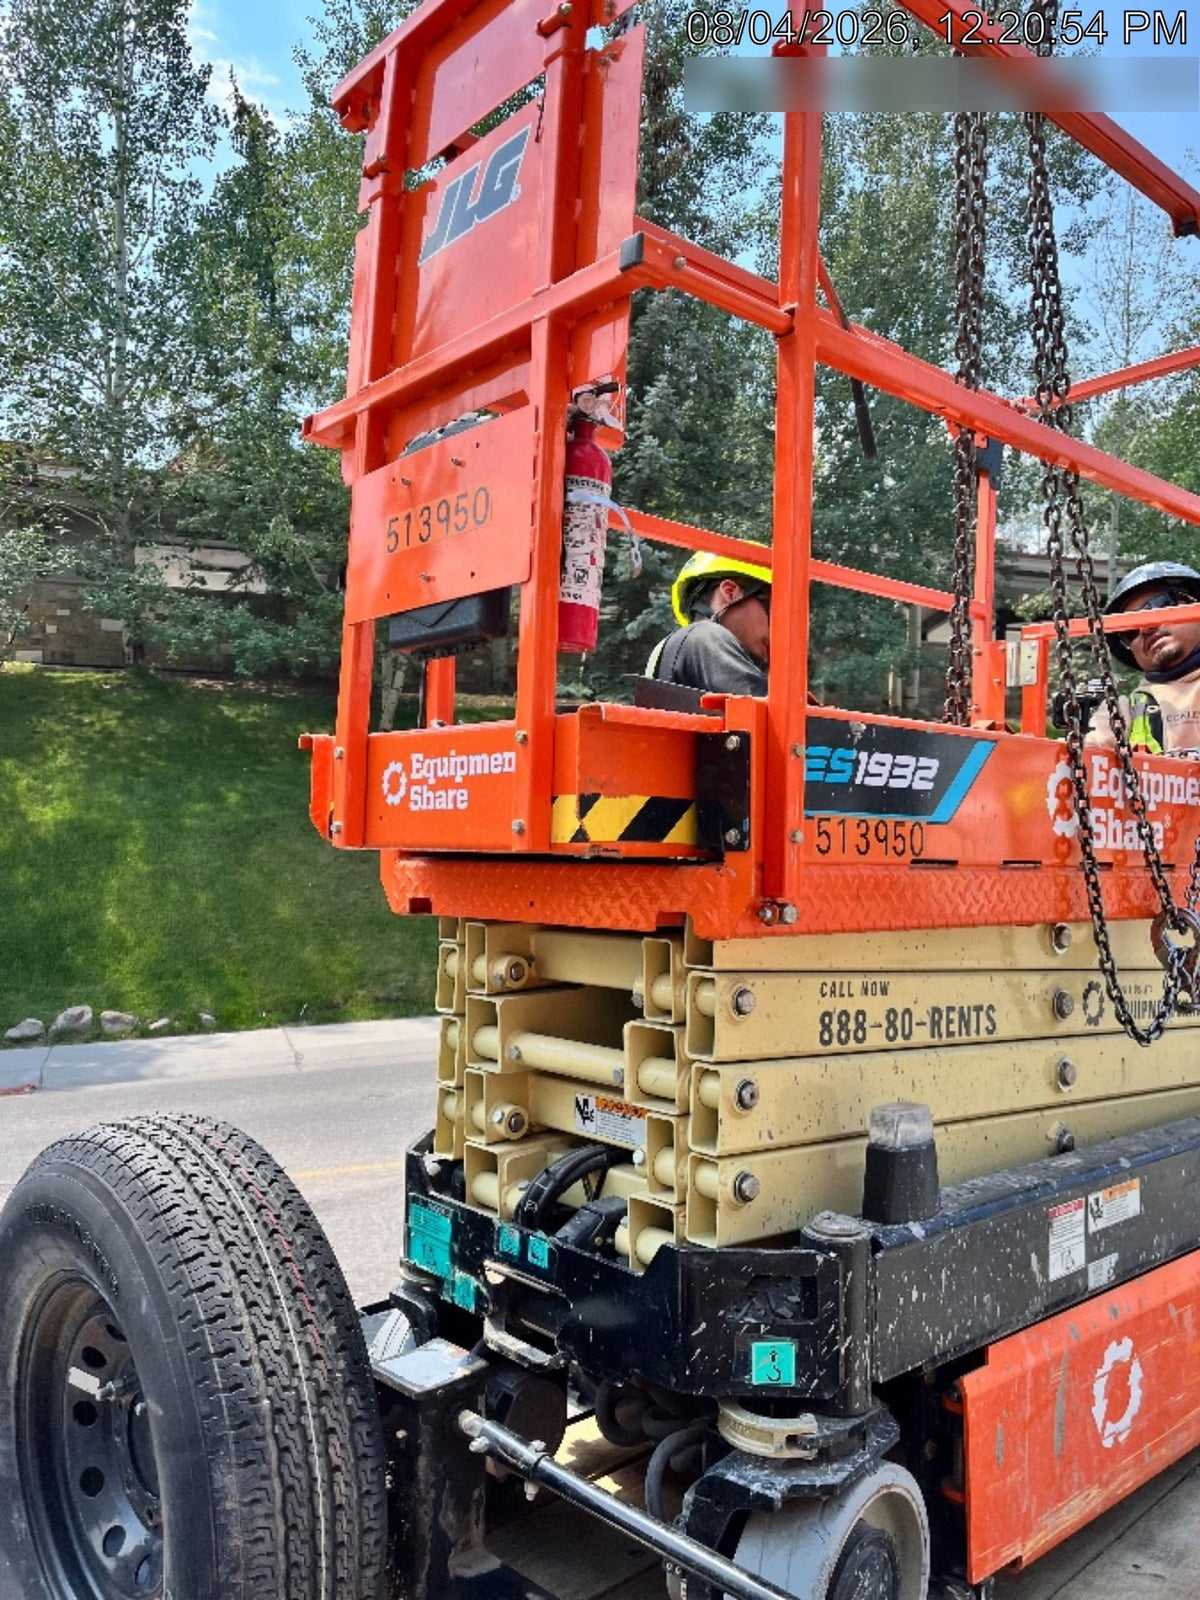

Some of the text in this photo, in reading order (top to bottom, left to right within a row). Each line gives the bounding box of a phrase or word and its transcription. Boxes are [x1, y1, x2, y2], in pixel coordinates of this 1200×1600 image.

[418, 123, 532, 267] JLG
[386, 486, 490, 554] 513950
[409, 784, 469, 811] Share
[815, 817, 924, 857] 513950
[820, 981, 890, 998] CALL NOW
[819, 1003, 997, 1047] 888-80-RENTS
